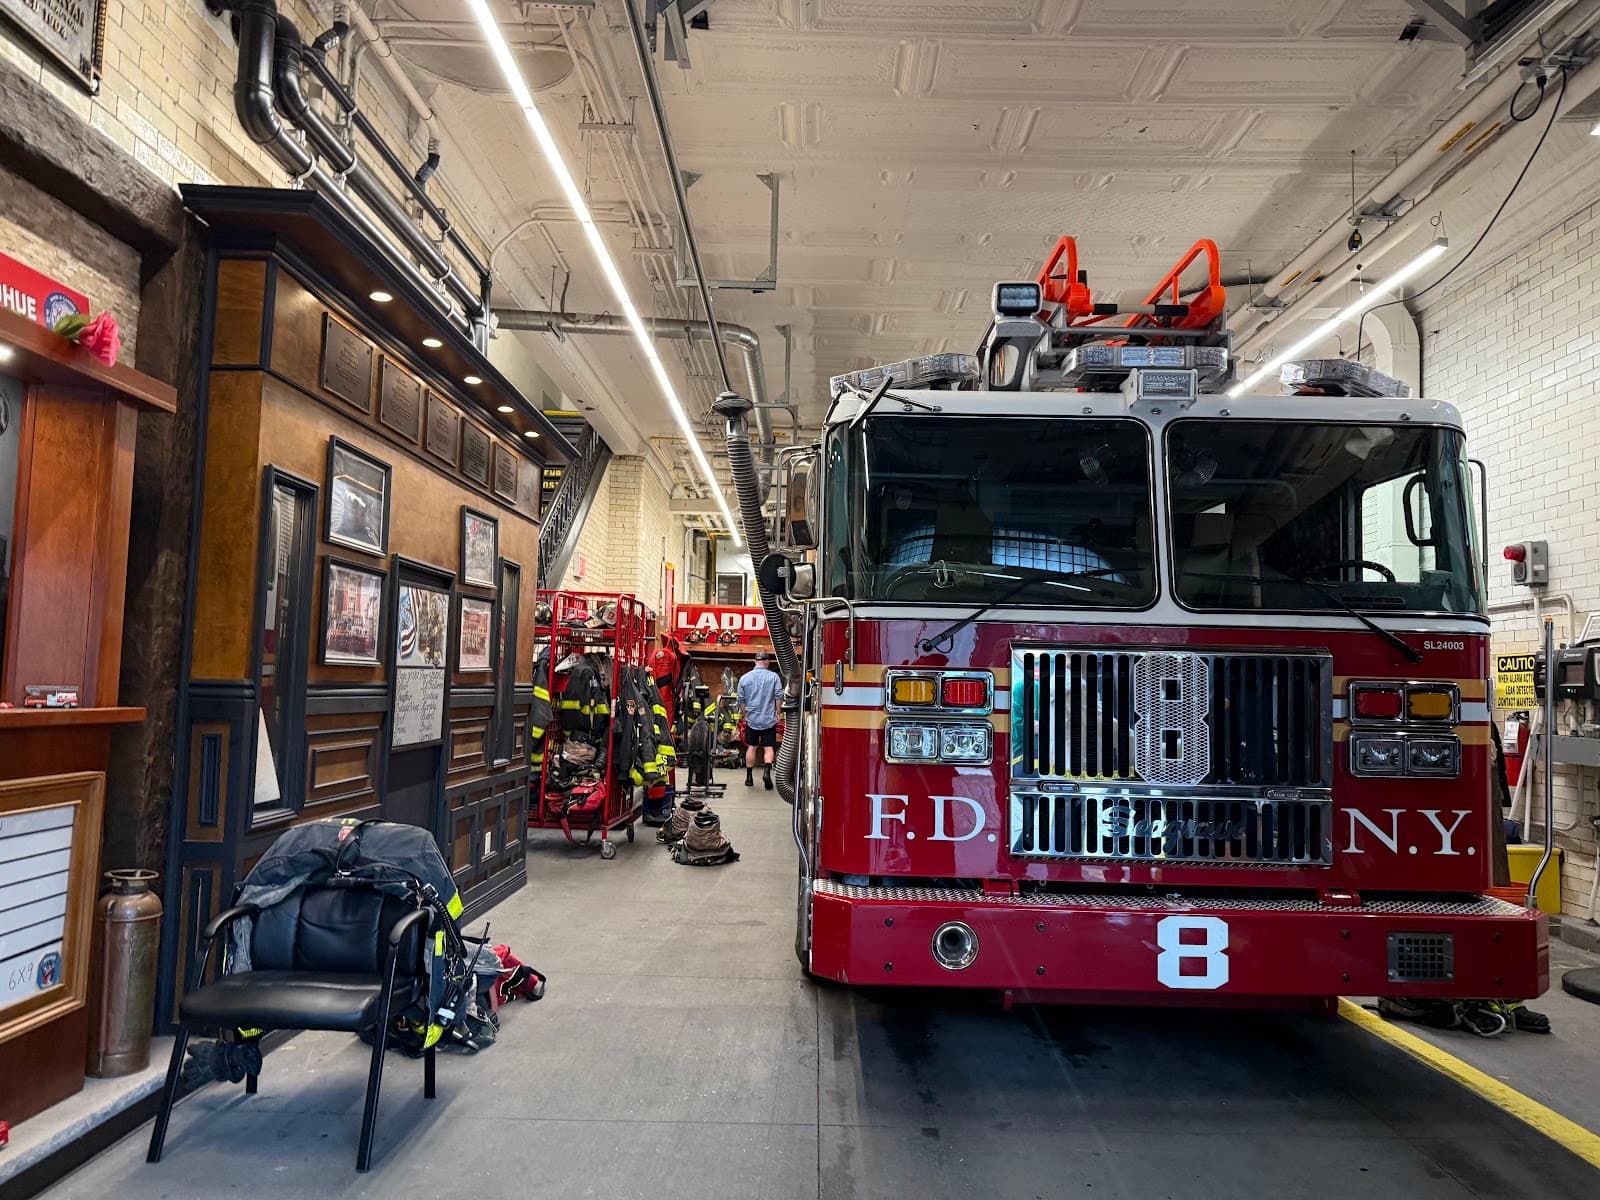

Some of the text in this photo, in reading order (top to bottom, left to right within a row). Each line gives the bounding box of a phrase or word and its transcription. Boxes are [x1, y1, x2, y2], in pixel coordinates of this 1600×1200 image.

[0, 283, 38, 321] HUE
[677, 611, 765, 631] LADD
[1423, 640, 1465, 651] SL24003
[1498, 656, 1535, 671] CAUTIO
[1523, 673, 1534, 683] ACTI
[1516, 686, 1534, 695] DETECTE
[1516, 697, 1537, 707] MAINTENA
[1133, 651, 1211, 786] 8
[864, 793, 997, 843] F.D.
[1340, 807, 1477, 856] N.Y.
[1156, 915, 1230, 990] 8
